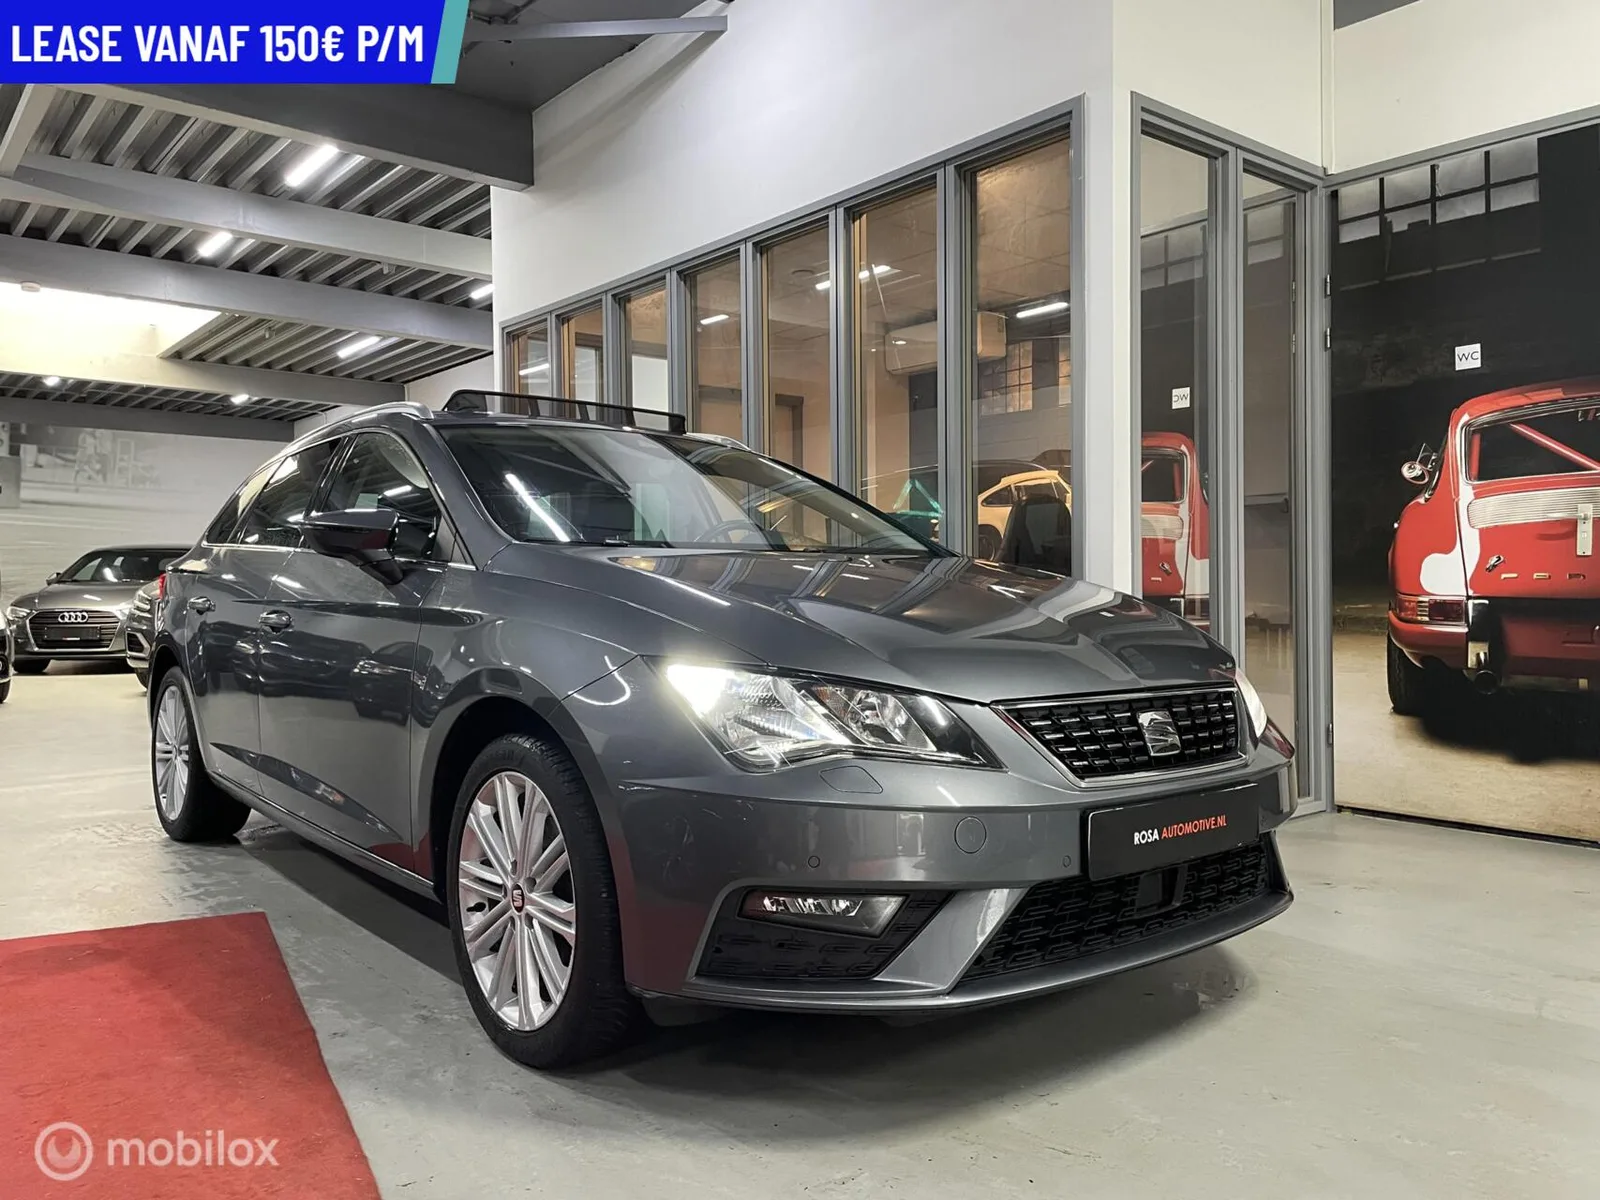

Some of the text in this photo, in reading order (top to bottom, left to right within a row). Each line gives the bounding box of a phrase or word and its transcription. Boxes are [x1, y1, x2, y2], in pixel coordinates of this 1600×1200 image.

[1457, 350, 1479, 362] WC
[1133, 815, 1227, 845] ROSA AUTOMOTIVE.NL
